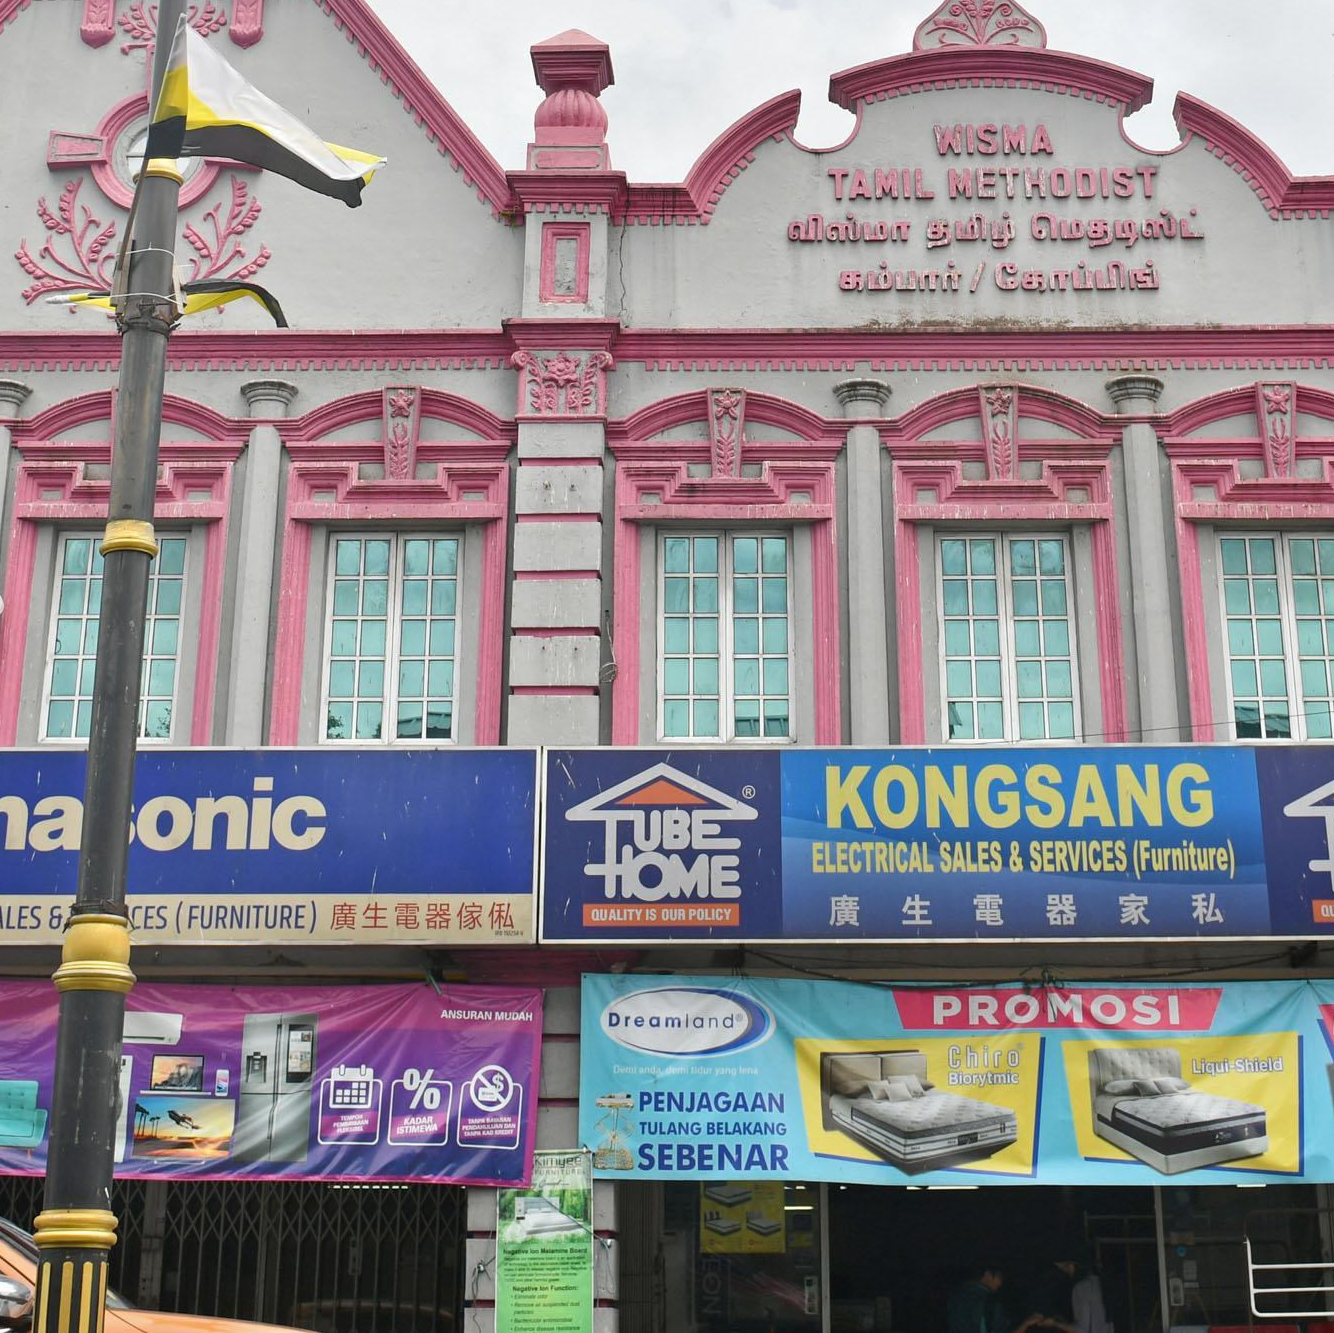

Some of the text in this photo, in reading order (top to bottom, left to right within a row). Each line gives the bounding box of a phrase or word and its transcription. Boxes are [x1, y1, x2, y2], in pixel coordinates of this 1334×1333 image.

[933, 123, 1054, 155] WISMA
[828, 166, 1158, 200] TAMIL METHODIST
[926, 212, 1016, 249] தமிழ்
[825, 762, 1214, 829] KONGSANG
[584, 844, 742, 901] HOME
[811, 839, 1236, 880] ELECTRICAL SALES & SERVICES (Furniture)
[330, 901, 515, 931] 廣生電器傢俬
[591, 908, 732, 922] QUALITY IS OUR POLICY
[829, 892, 1225, 926] 廣生電器家私
[441, 1010, 533, 1022] ANSURAN MUDAH
[933, 994, 1180, 1025] PROMOSI
[948, 1044, 1019, 1068] Chiro
[1191, 1056, 1284, 1076] Liqui-Shield
[948, 1070, 1019, 1087] Biorytmic
[639, 1091, 785, 1113] PENJAGAAN
[396, 1123, 438, 1134] ISTIMEWA
[404, 1116, 433, 1124] KADAR
[640, 1122, 787, 1136] TULANG BELAKANG
[638, 1143, 789, 1171] SEBENAR
